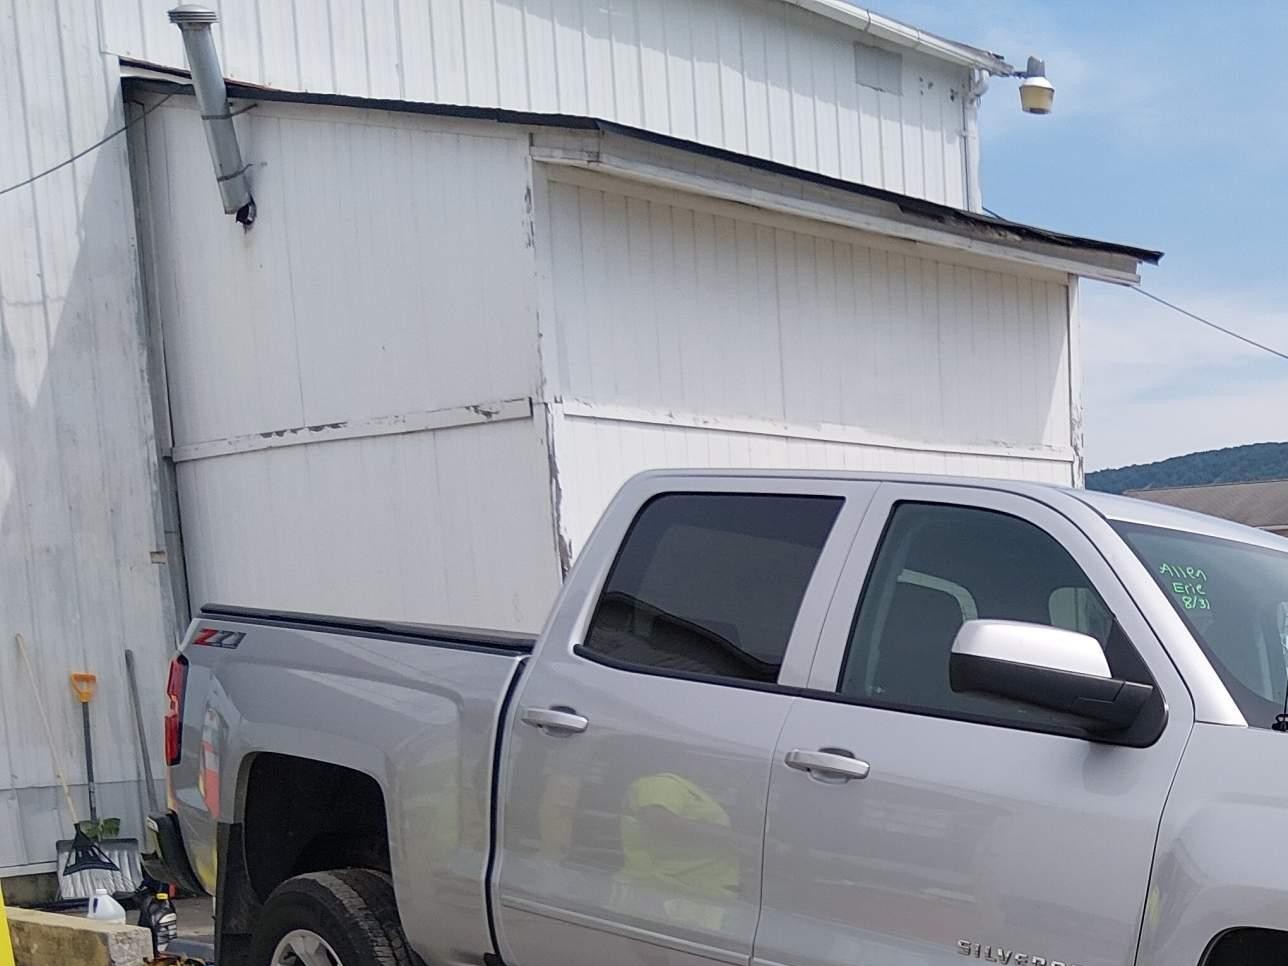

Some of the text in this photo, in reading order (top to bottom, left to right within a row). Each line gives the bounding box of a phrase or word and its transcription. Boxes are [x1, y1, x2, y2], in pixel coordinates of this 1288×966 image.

[1159, 563, 1207, 581] Allen
[1172, 582, 1206, 595] Eric
[1182, 595, 1210, 610] 8/31
[192, 628, 247, 650] Z71
